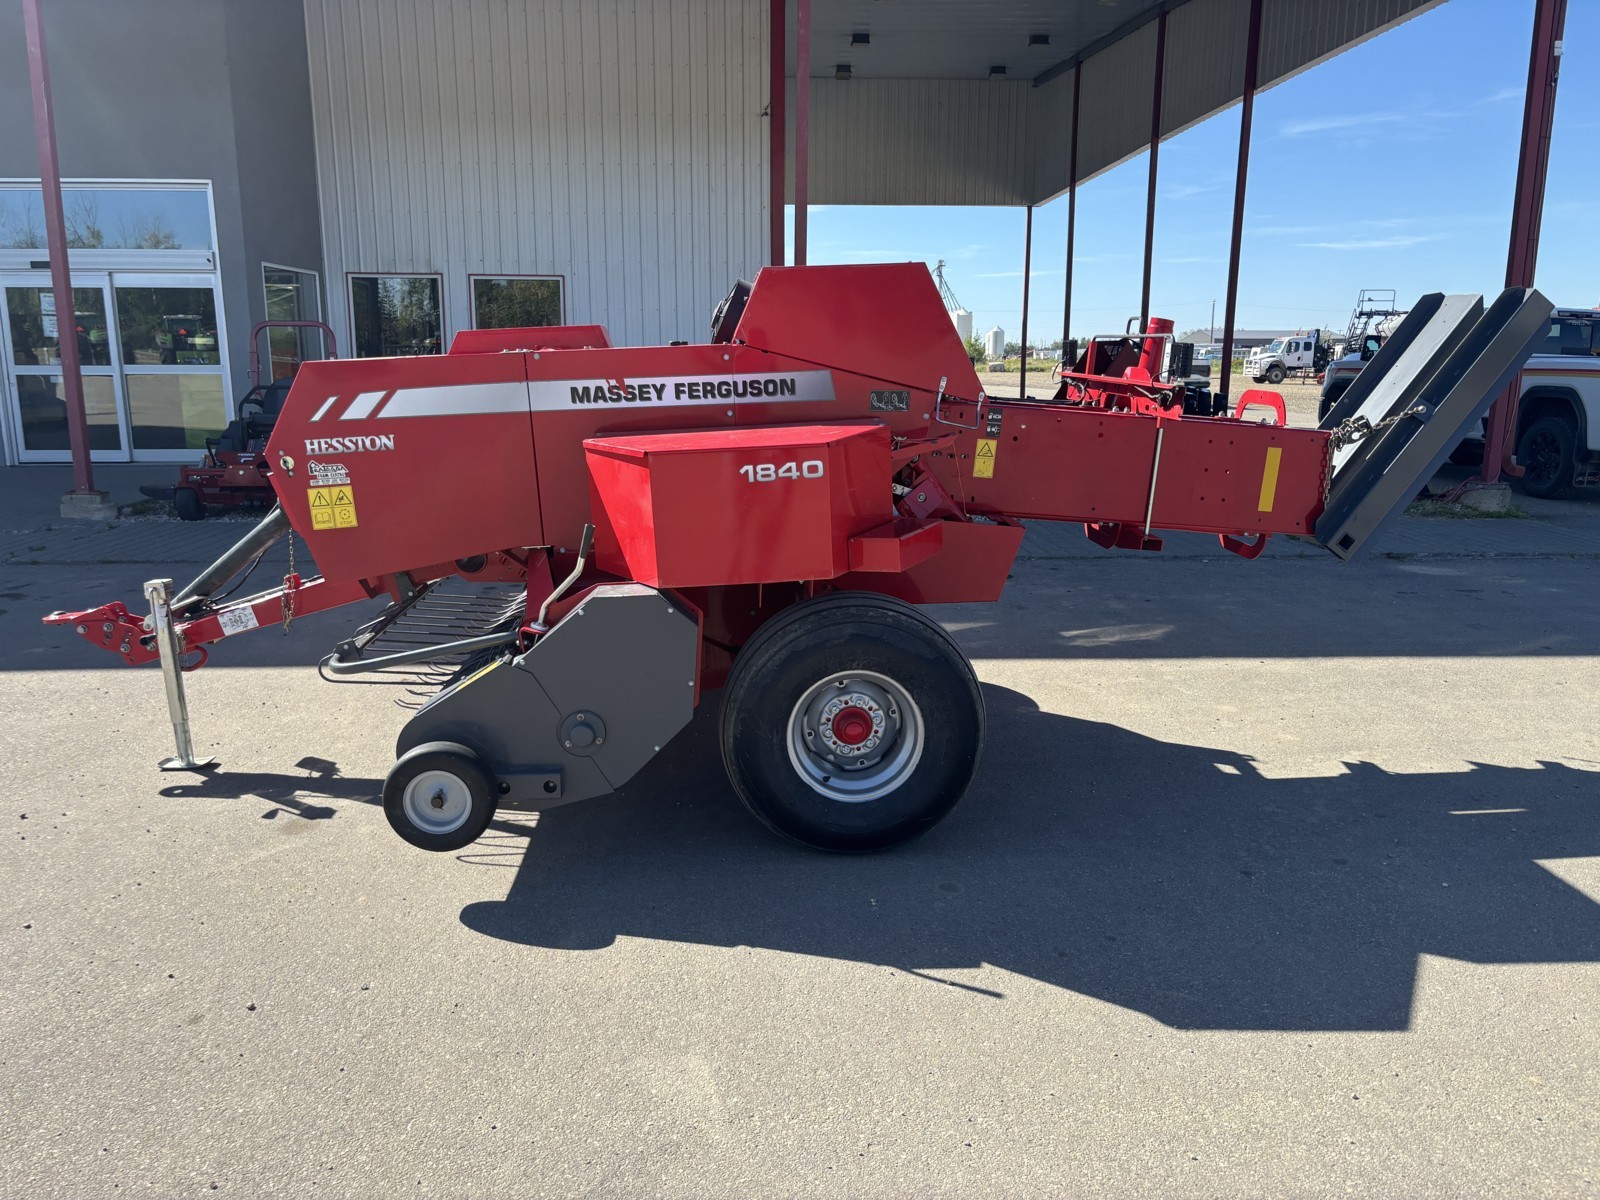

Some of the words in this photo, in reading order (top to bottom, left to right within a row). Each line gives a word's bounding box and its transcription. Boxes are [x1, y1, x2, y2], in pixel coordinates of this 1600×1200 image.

[570, 383, 666, 404] MASSEY
[674, 378, 796, 401] FERGUSON
[304, 434, 395, 456] HESSTON
[739, 460, 825, 483] 1840
